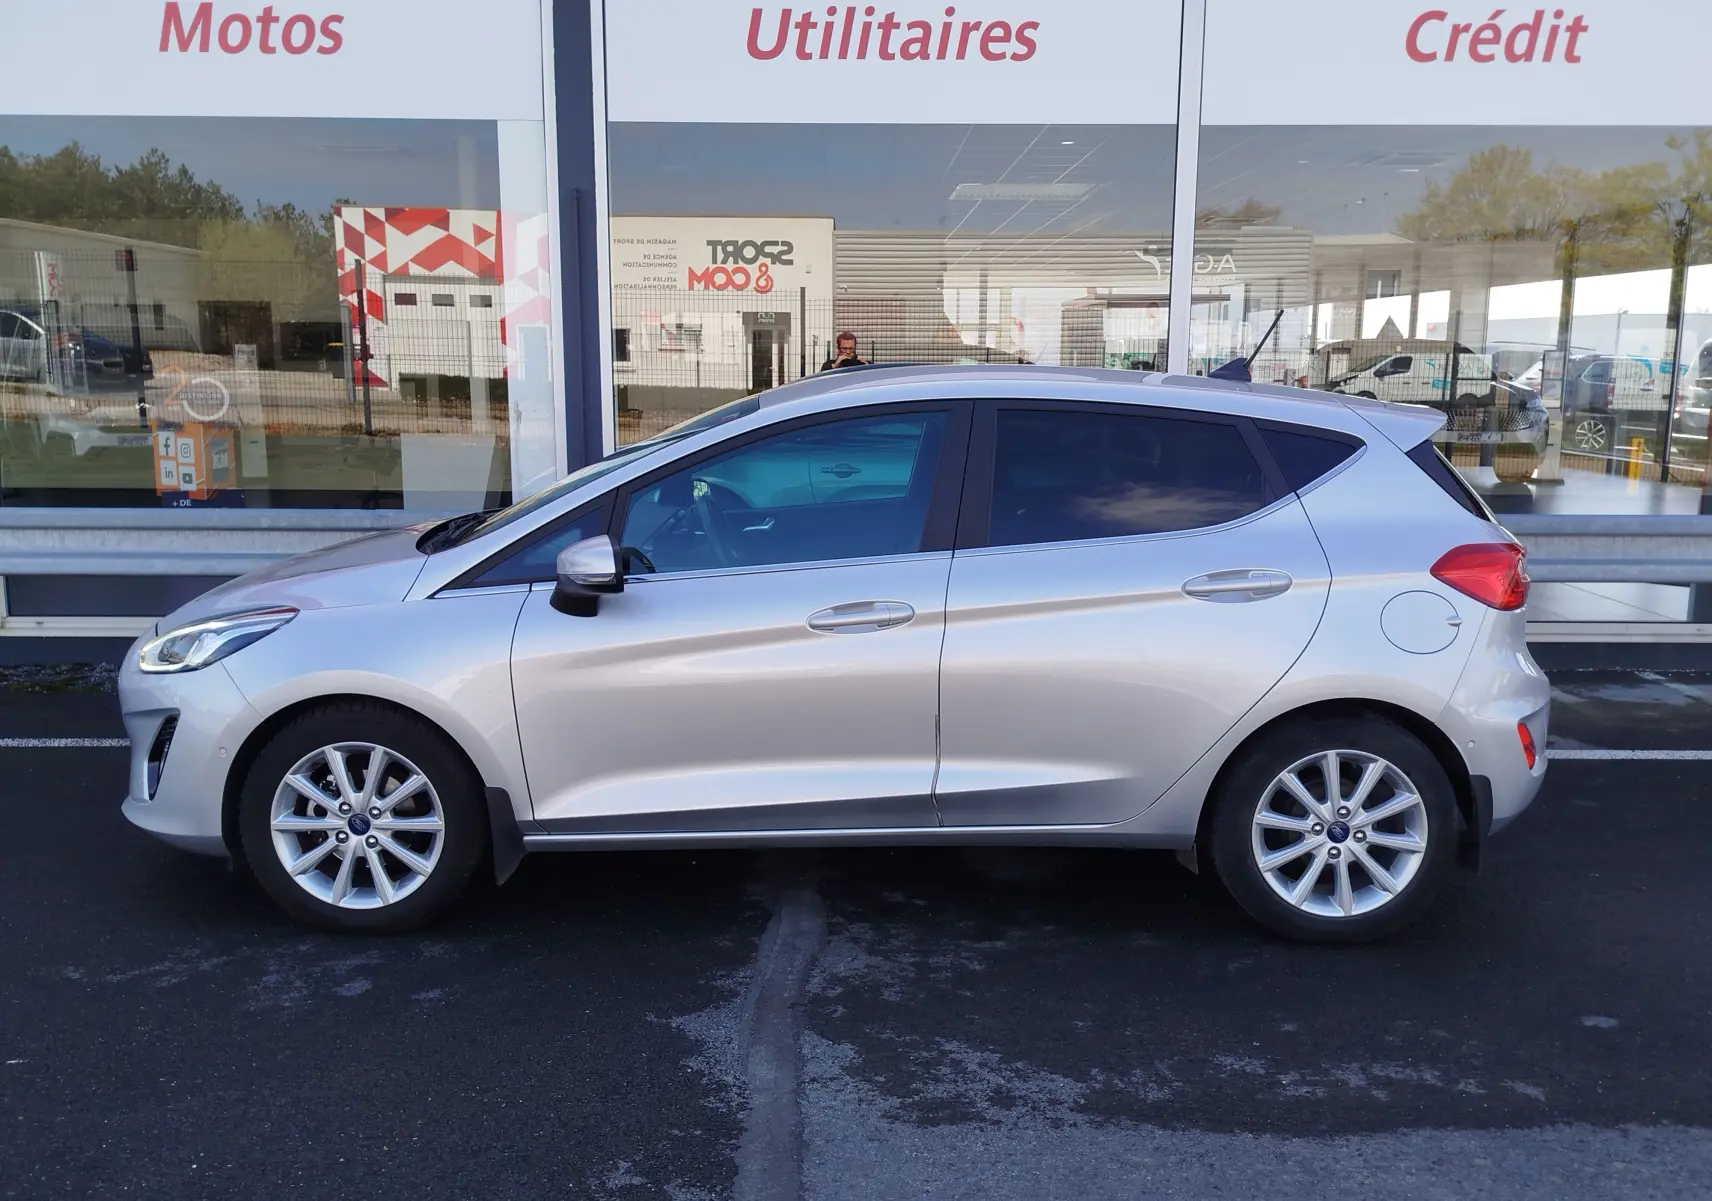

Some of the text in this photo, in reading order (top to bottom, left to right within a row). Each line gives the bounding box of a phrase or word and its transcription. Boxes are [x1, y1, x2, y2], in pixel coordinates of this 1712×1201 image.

[159, 1, 345, 55] Motos
[746, 5, 1040, 62] Utilitaires
[1405, 9, 1589, 63] Crédit
